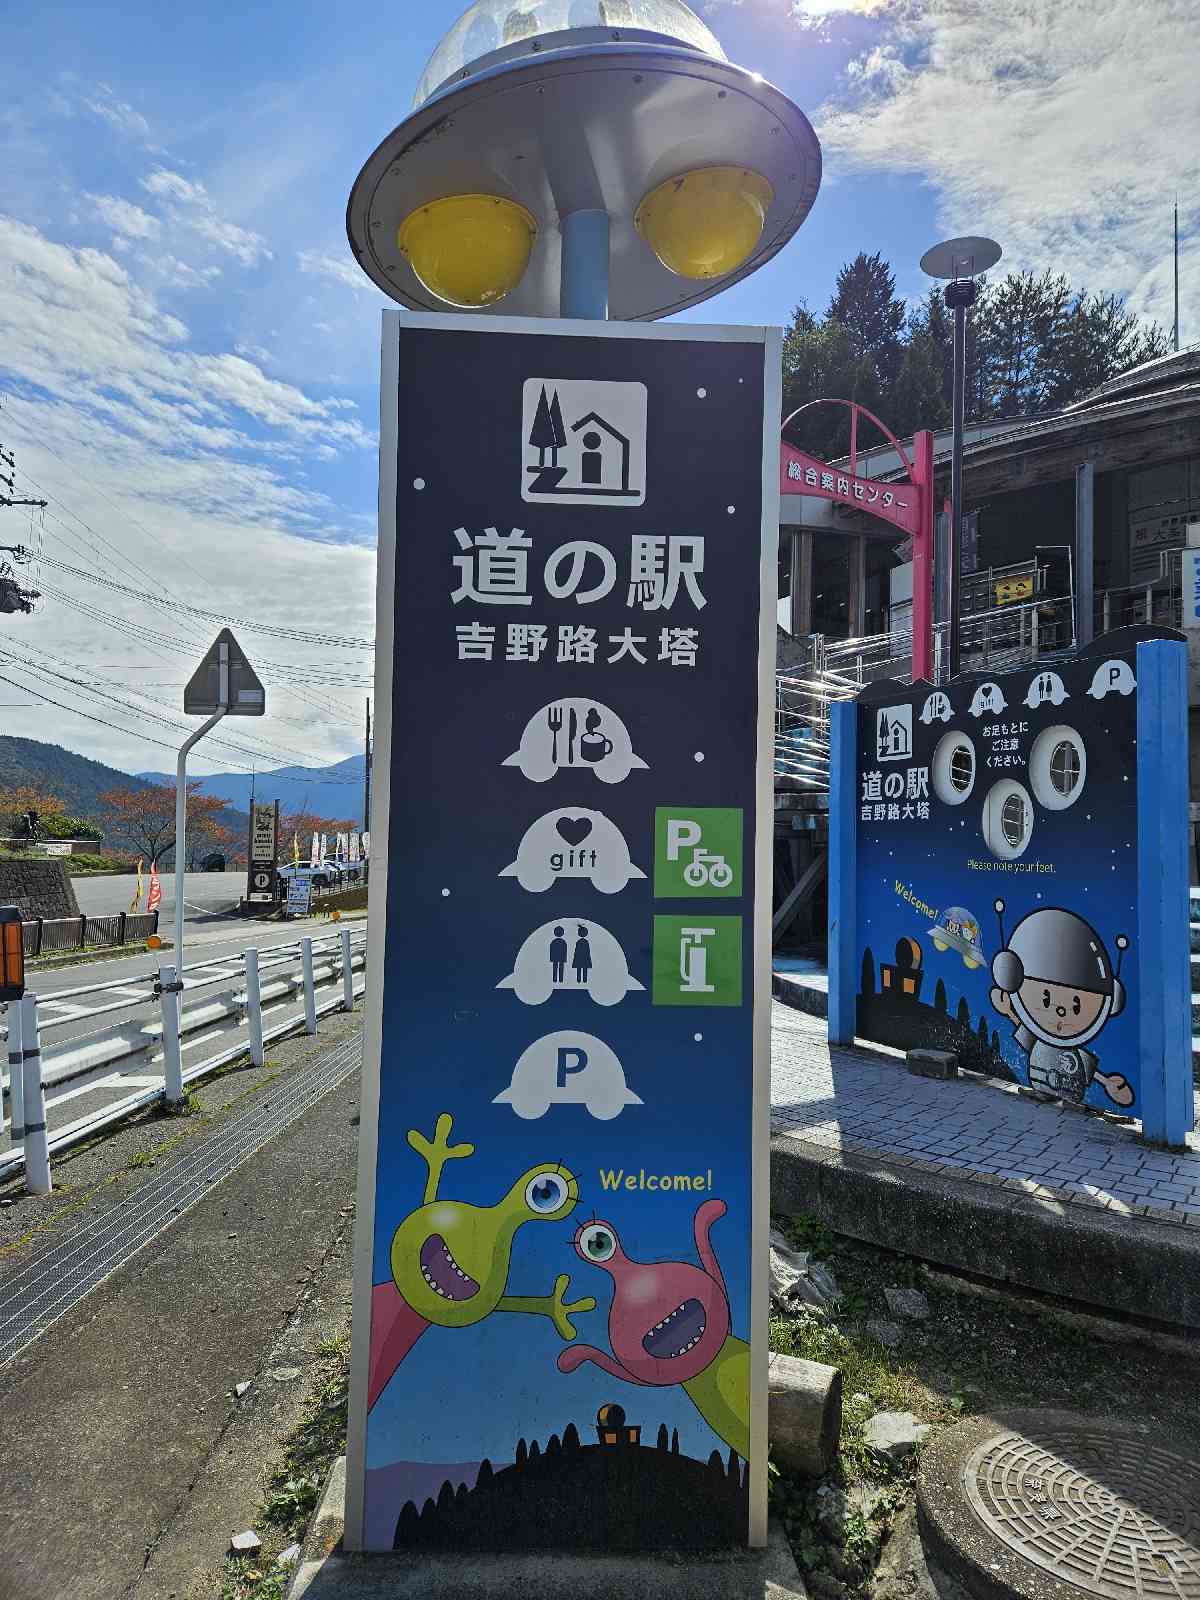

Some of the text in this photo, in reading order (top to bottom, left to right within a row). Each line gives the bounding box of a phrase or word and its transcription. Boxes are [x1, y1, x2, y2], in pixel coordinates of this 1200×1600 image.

[787, 462, 909, 508] 総合案内センター
[450, 527, 708, 611] 道の駅
[455, 621, 700, 667] 吉野路大塔
[1109, 667, 1121, 684] P
[982, 721, 1029, 737] お足もとに
[991, 738, 1019, 751] ご注意
[985, 754, 1026, 767] ください。
[862, 766, 929, 801] 道の駅
[861, 801, 930, 821] 吉野路大塔
[667, 820, 702, 861] P
[549, 850, 599, 872] gift
[967, 858, 1057, 874] Please note your feet.
[895, 879, 939, 921] Welcome!
[556, 1047, 588, 1088] P
[599, 1168, 714, 1192] Welcome!
